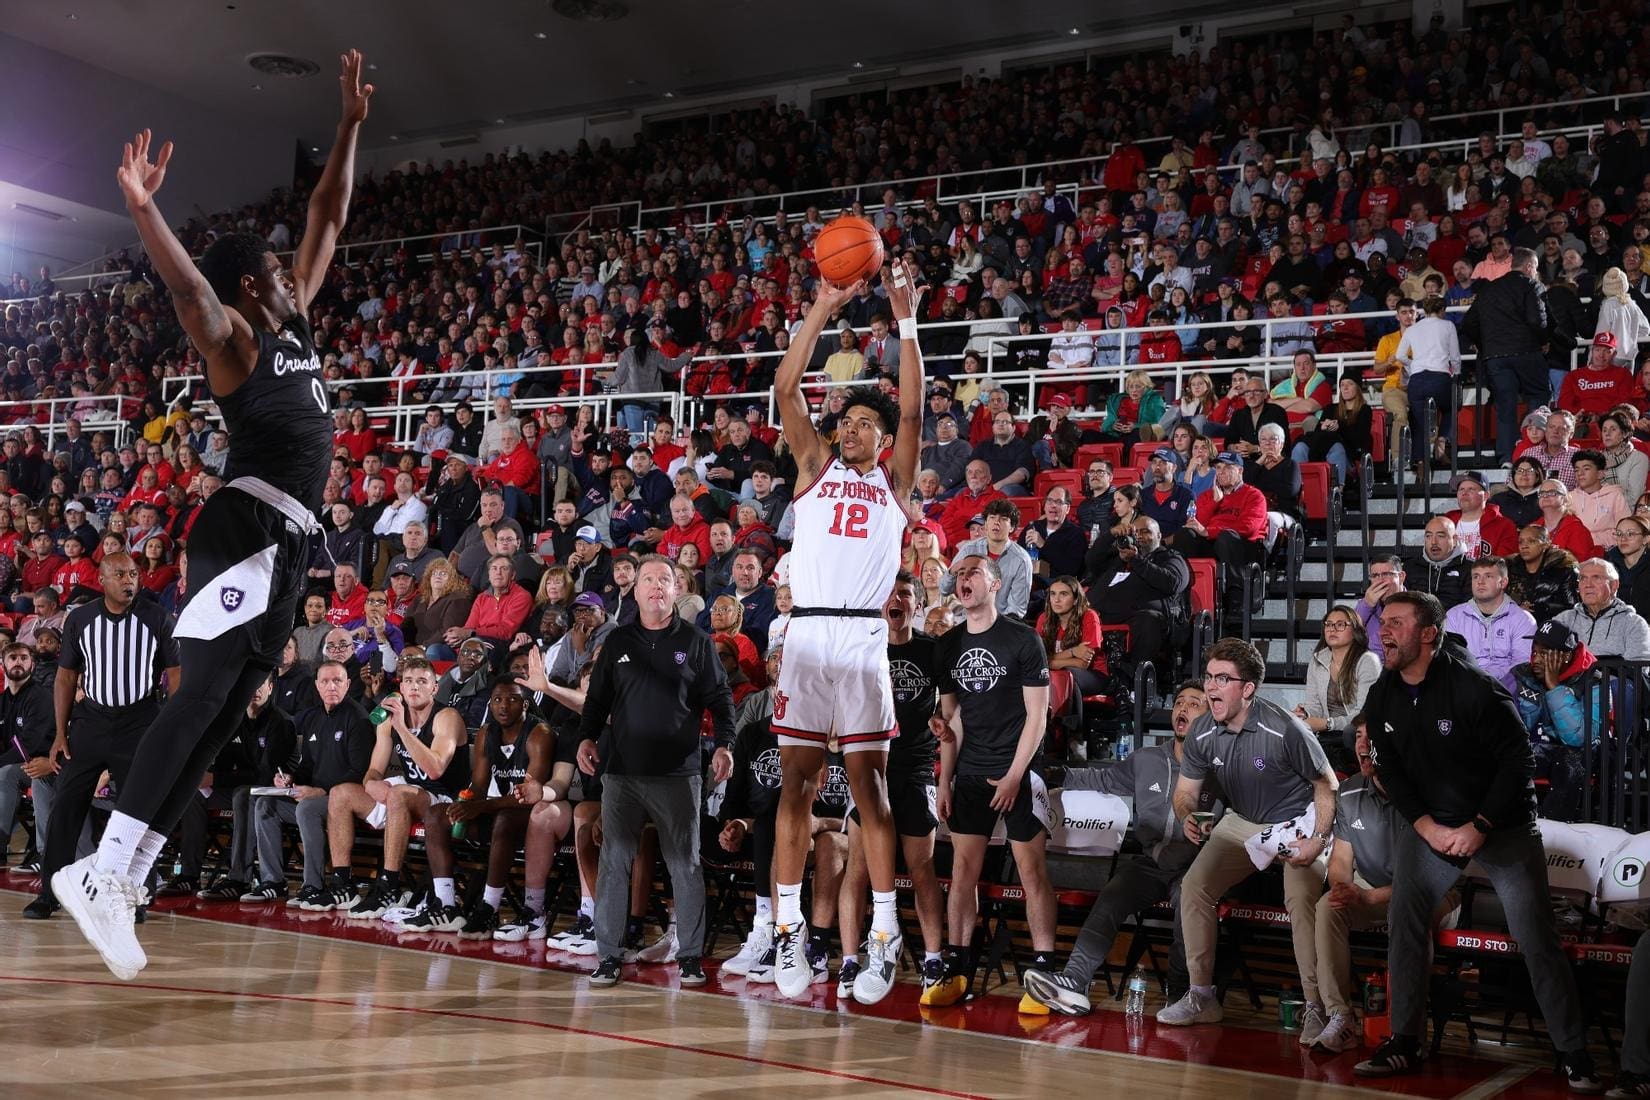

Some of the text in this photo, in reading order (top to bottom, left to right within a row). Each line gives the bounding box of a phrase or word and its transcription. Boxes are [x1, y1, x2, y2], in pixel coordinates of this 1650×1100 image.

[311, 377, 328, 414] 0
[828, 501, 869, 539] 12
[951, 666, 1007, 679] HOLY CROSS
[898, 677, 932, 688] CROSS
[749, 761, 769, 773] HOLY
[1062, 817, 1114, 831] Prolific1
[1546, 854, 1586, 869] lific1
[894, 878, 913, 888] RED
[1002, 889, 1023, 899] RED
[1231, 908, 1291, 922] RED STORM
[1456, 936, 1481, 948] RED
[1586, 950, 1613, 963] RED
